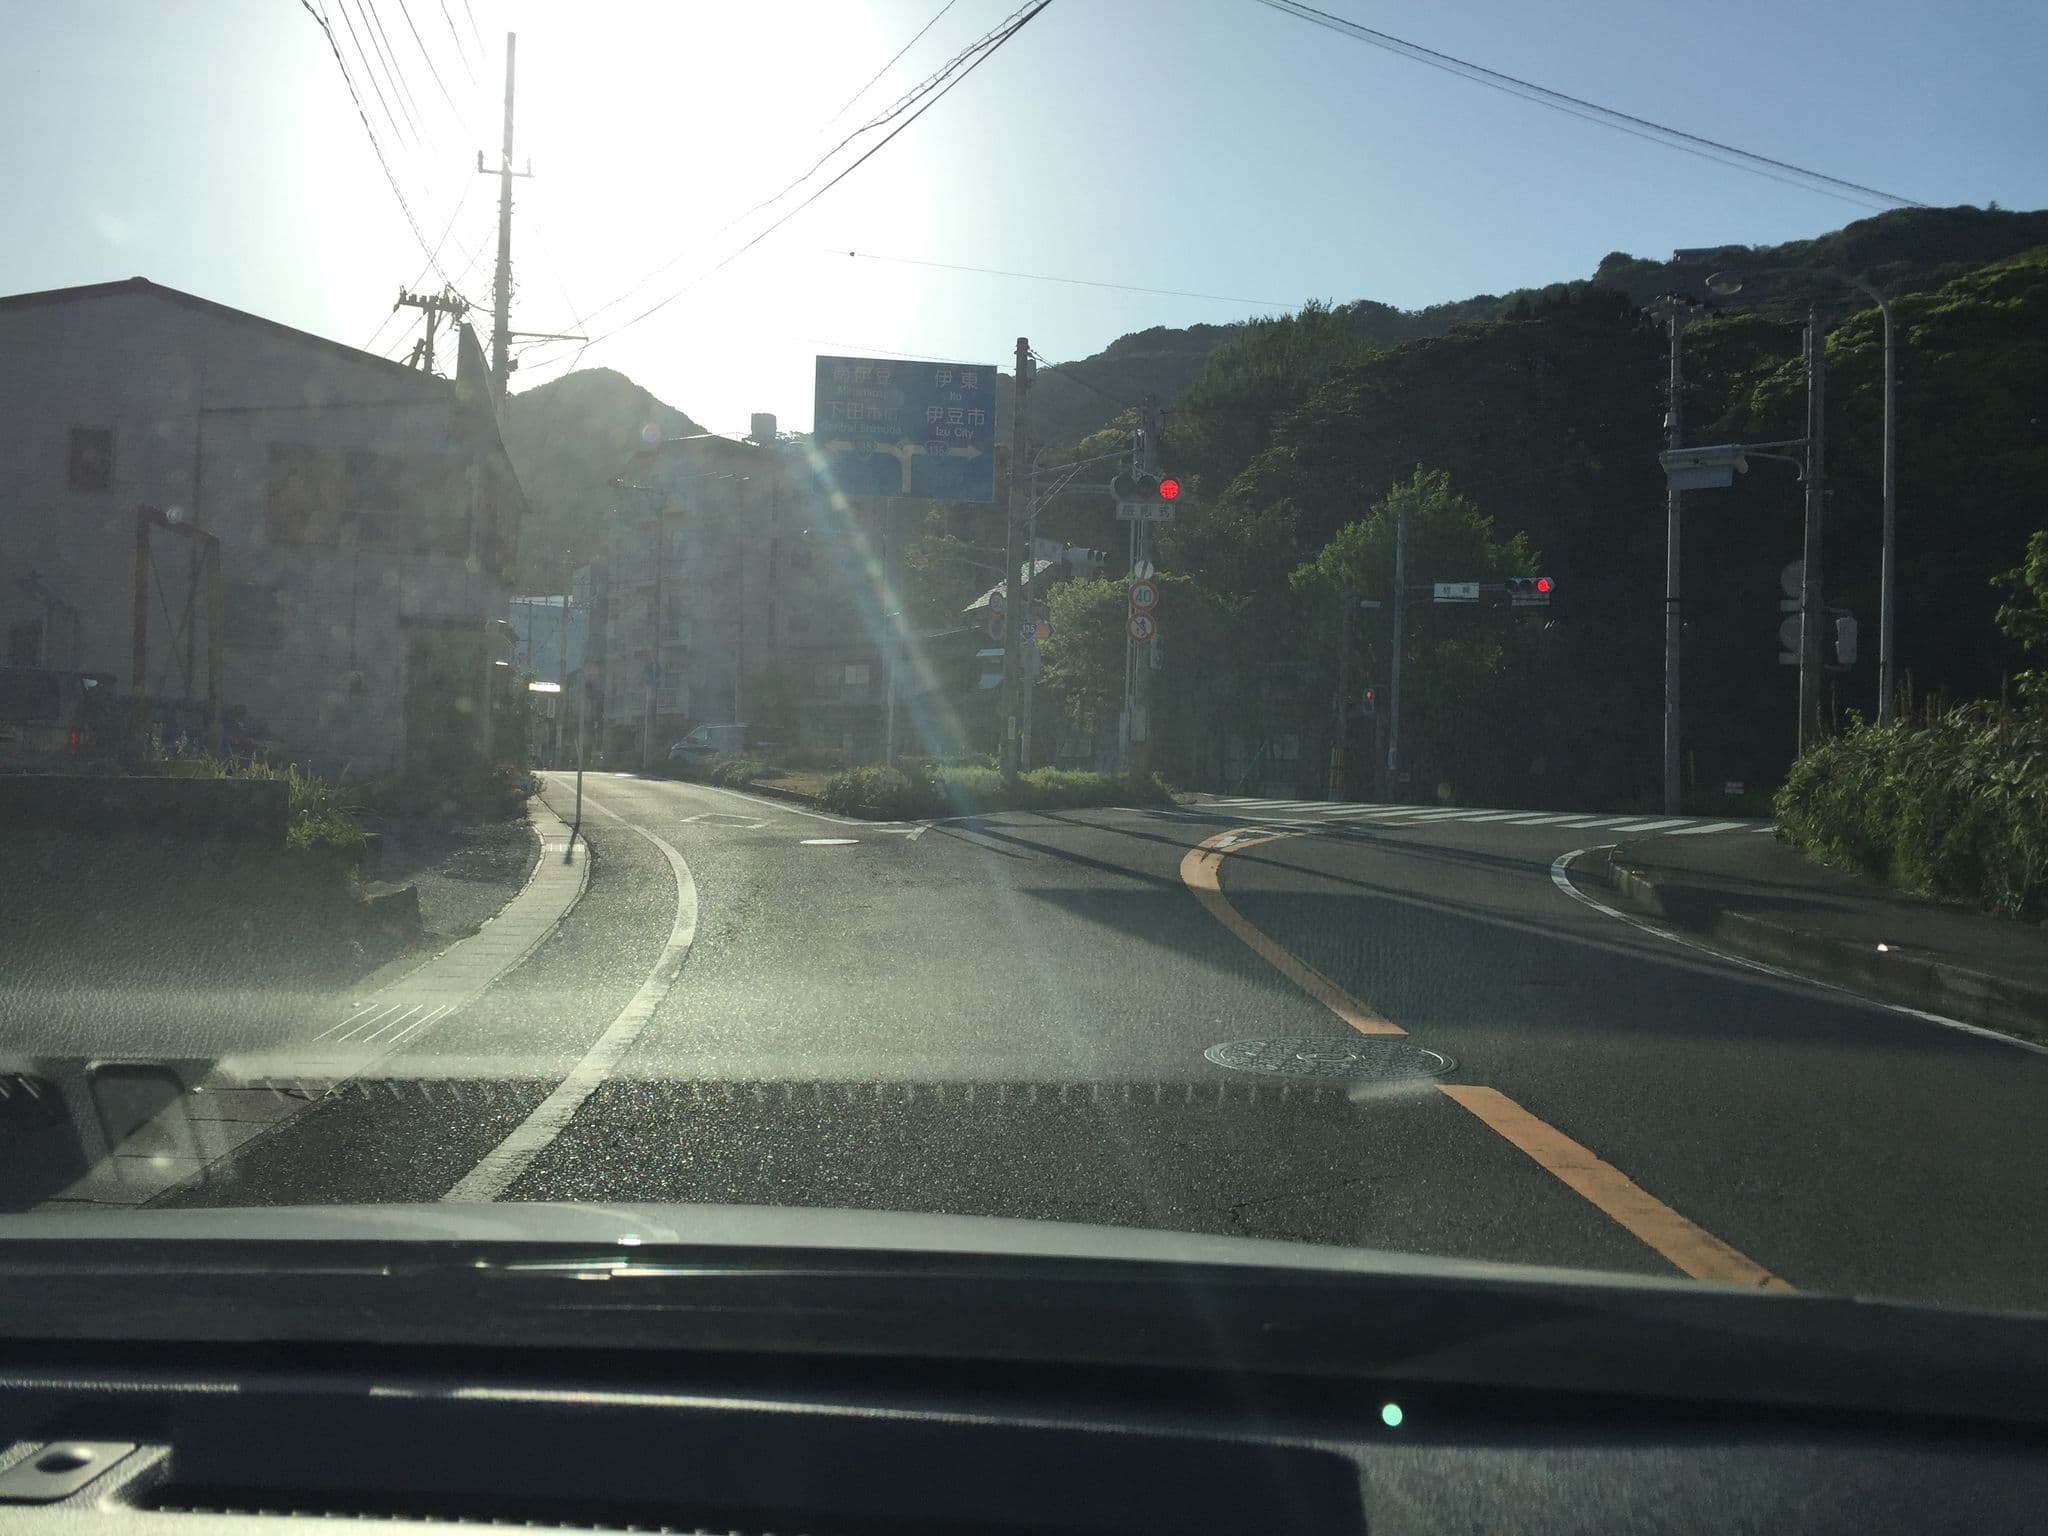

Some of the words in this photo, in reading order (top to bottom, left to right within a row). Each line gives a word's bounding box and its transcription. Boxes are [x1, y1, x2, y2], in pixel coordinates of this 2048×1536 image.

[935, 369, 978, 389] 伊東
[927, 406, 985, 426] 伊豆市
[936, 427, 949, 437] Izu
[954, 428, 974, 439] City
[1135, 589, 1152, 603] 40
